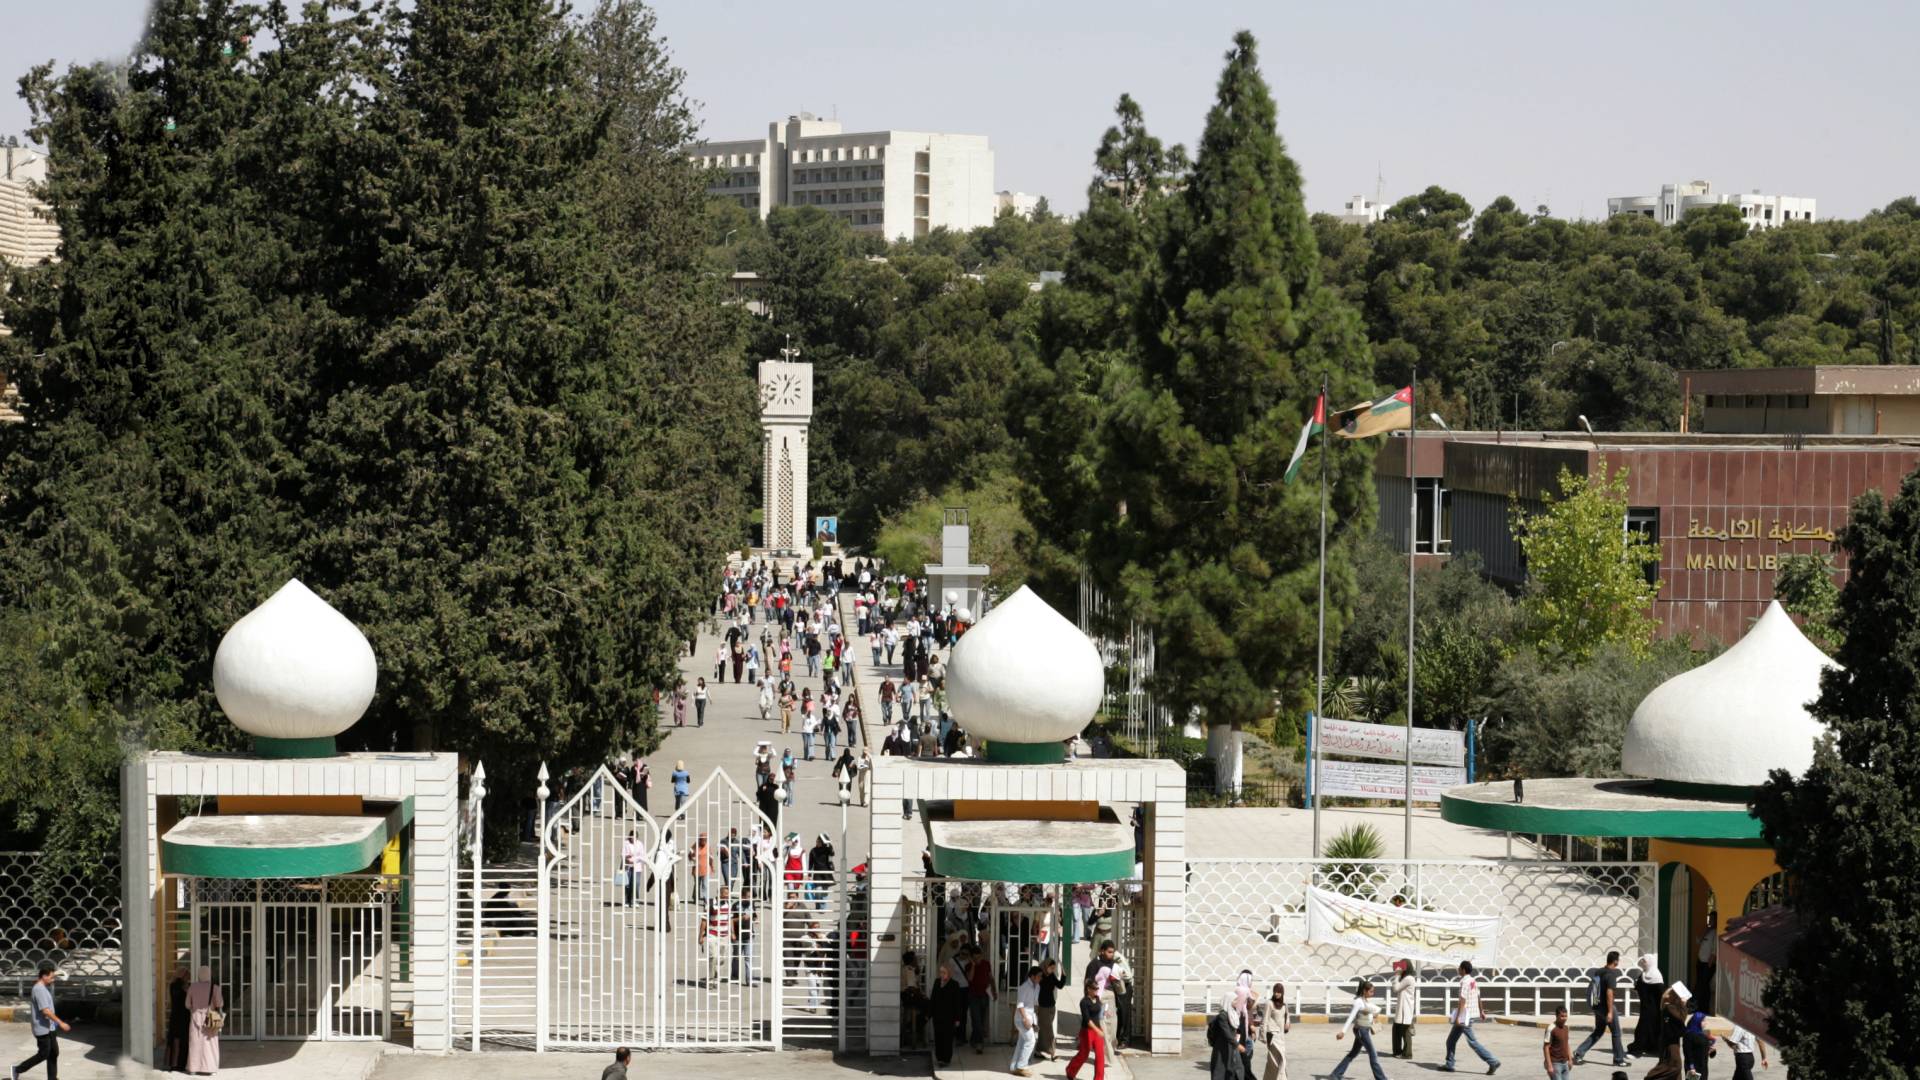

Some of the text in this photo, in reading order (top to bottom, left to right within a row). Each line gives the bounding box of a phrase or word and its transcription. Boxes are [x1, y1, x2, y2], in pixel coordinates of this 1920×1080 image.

[1687, 517, 1837, 545] مكتبة الجامعة
[1686, 554, 1783, 570] MAIN LIB
[1390, 786, 1407, 795] Trave
[1379, 921, 1426, 943] الكتاب
[1426, 928, 1477, 951] معرض
